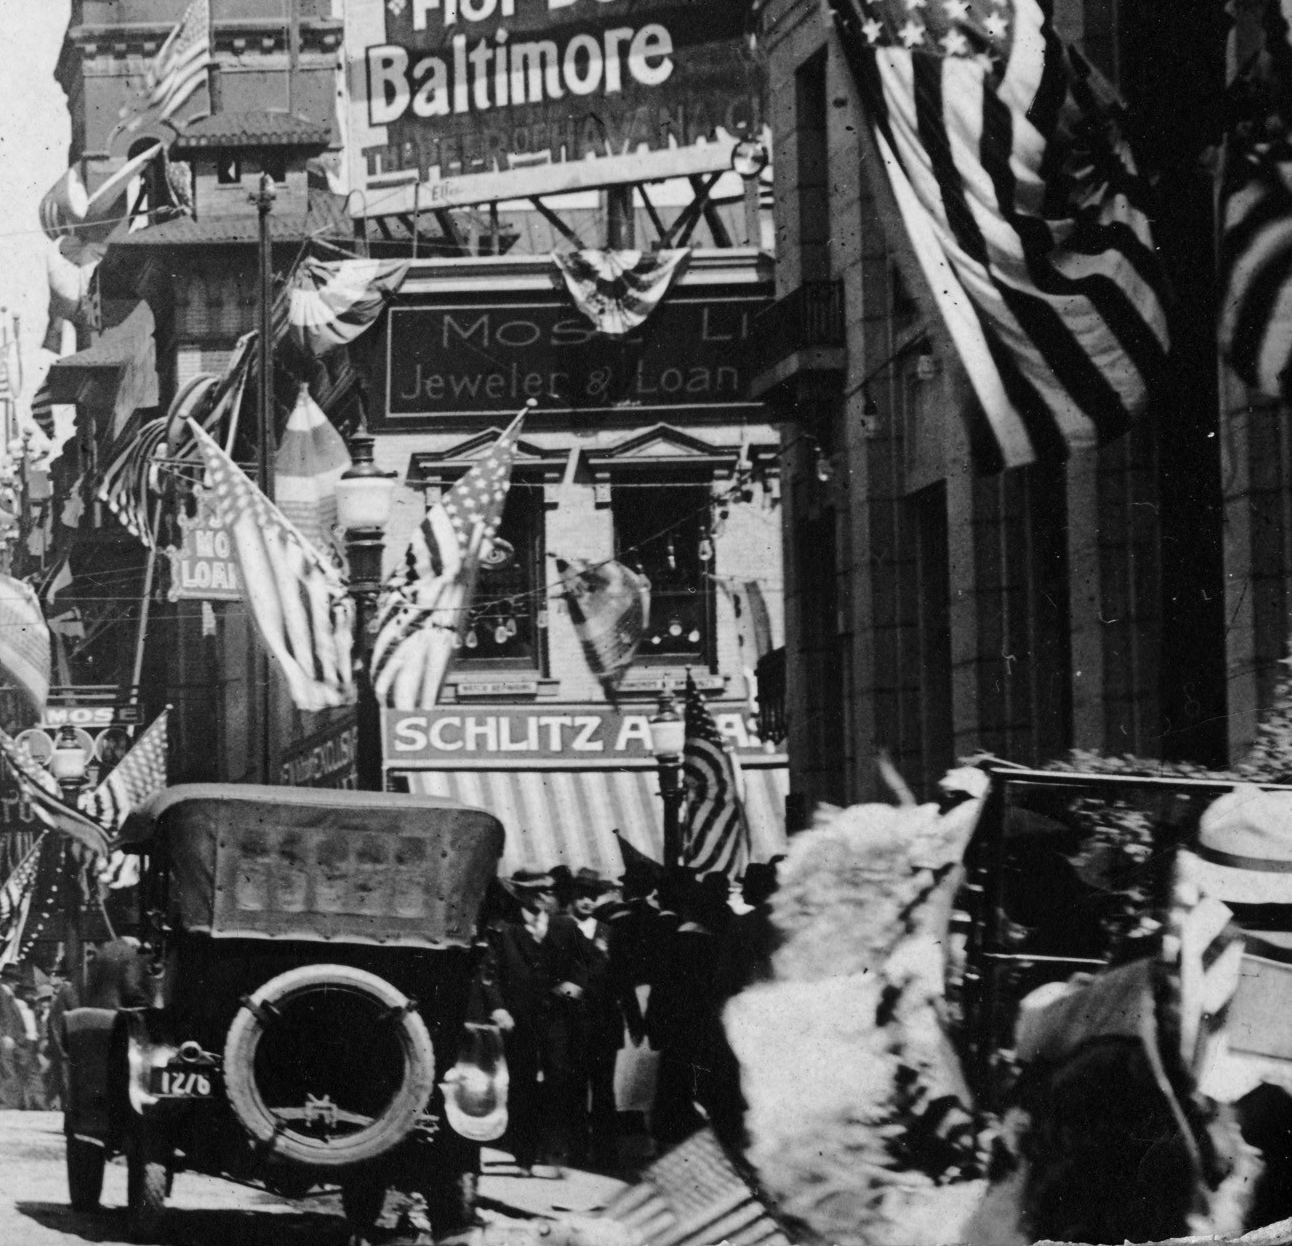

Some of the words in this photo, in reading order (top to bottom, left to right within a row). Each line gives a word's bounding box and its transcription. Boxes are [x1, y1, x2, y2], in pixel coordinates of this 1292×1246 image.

[367, 23, 675, 126] Baltimore
[401, 361, 569, 401] Jeweler
[637, 359, 739, 395] Loan
[46, 706, 138, 726] MOSE
[393, 715, 604, 752] SCHLITZ
